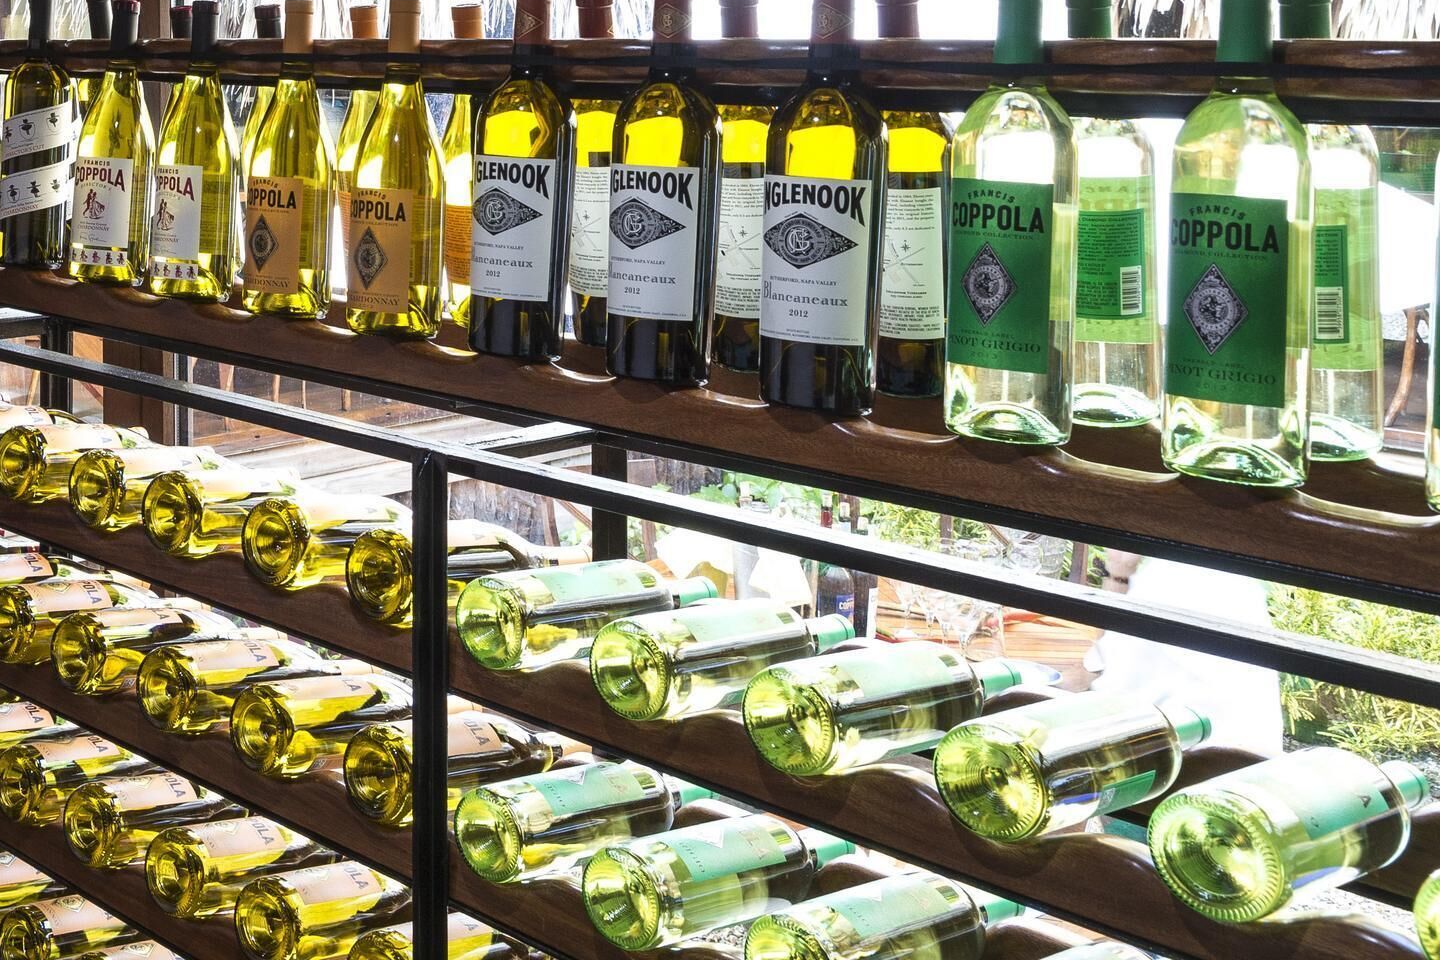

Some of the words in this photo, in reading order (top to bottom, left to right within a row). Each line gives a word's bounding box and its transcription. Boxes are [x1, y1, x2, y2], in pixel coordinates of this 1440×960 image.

[84, 159, 110, 167] FRANCIS
[75, 166, 125, 192] COPPOLA
[474, 160, 551, 200] GLENOOK
[248, 188, 297, 209] OPPOLA
[967, 188, 1016, 204] FRANCIS
[952, 201, 1046, 234] COPPOLA
[1189, 204, 1246, 221] FRANCIS
[1170, 217, 1280, 254] COPPOLA
[472, 246, 533, 269] lancaneaux
[485, 270, 501, 278] 2012
[609, 261, 677, 285] lancaneaux
[800, 278, 815, 286] NAPA
[624, 286, 641, 295] 2012
[763, 280, 848, 307] Blancaneaux
[788, 308, 809, 318] 2012
[981, 338, 1041, 354] GRIGIO
[1207, 367, 1277, 386] GRIGIO
